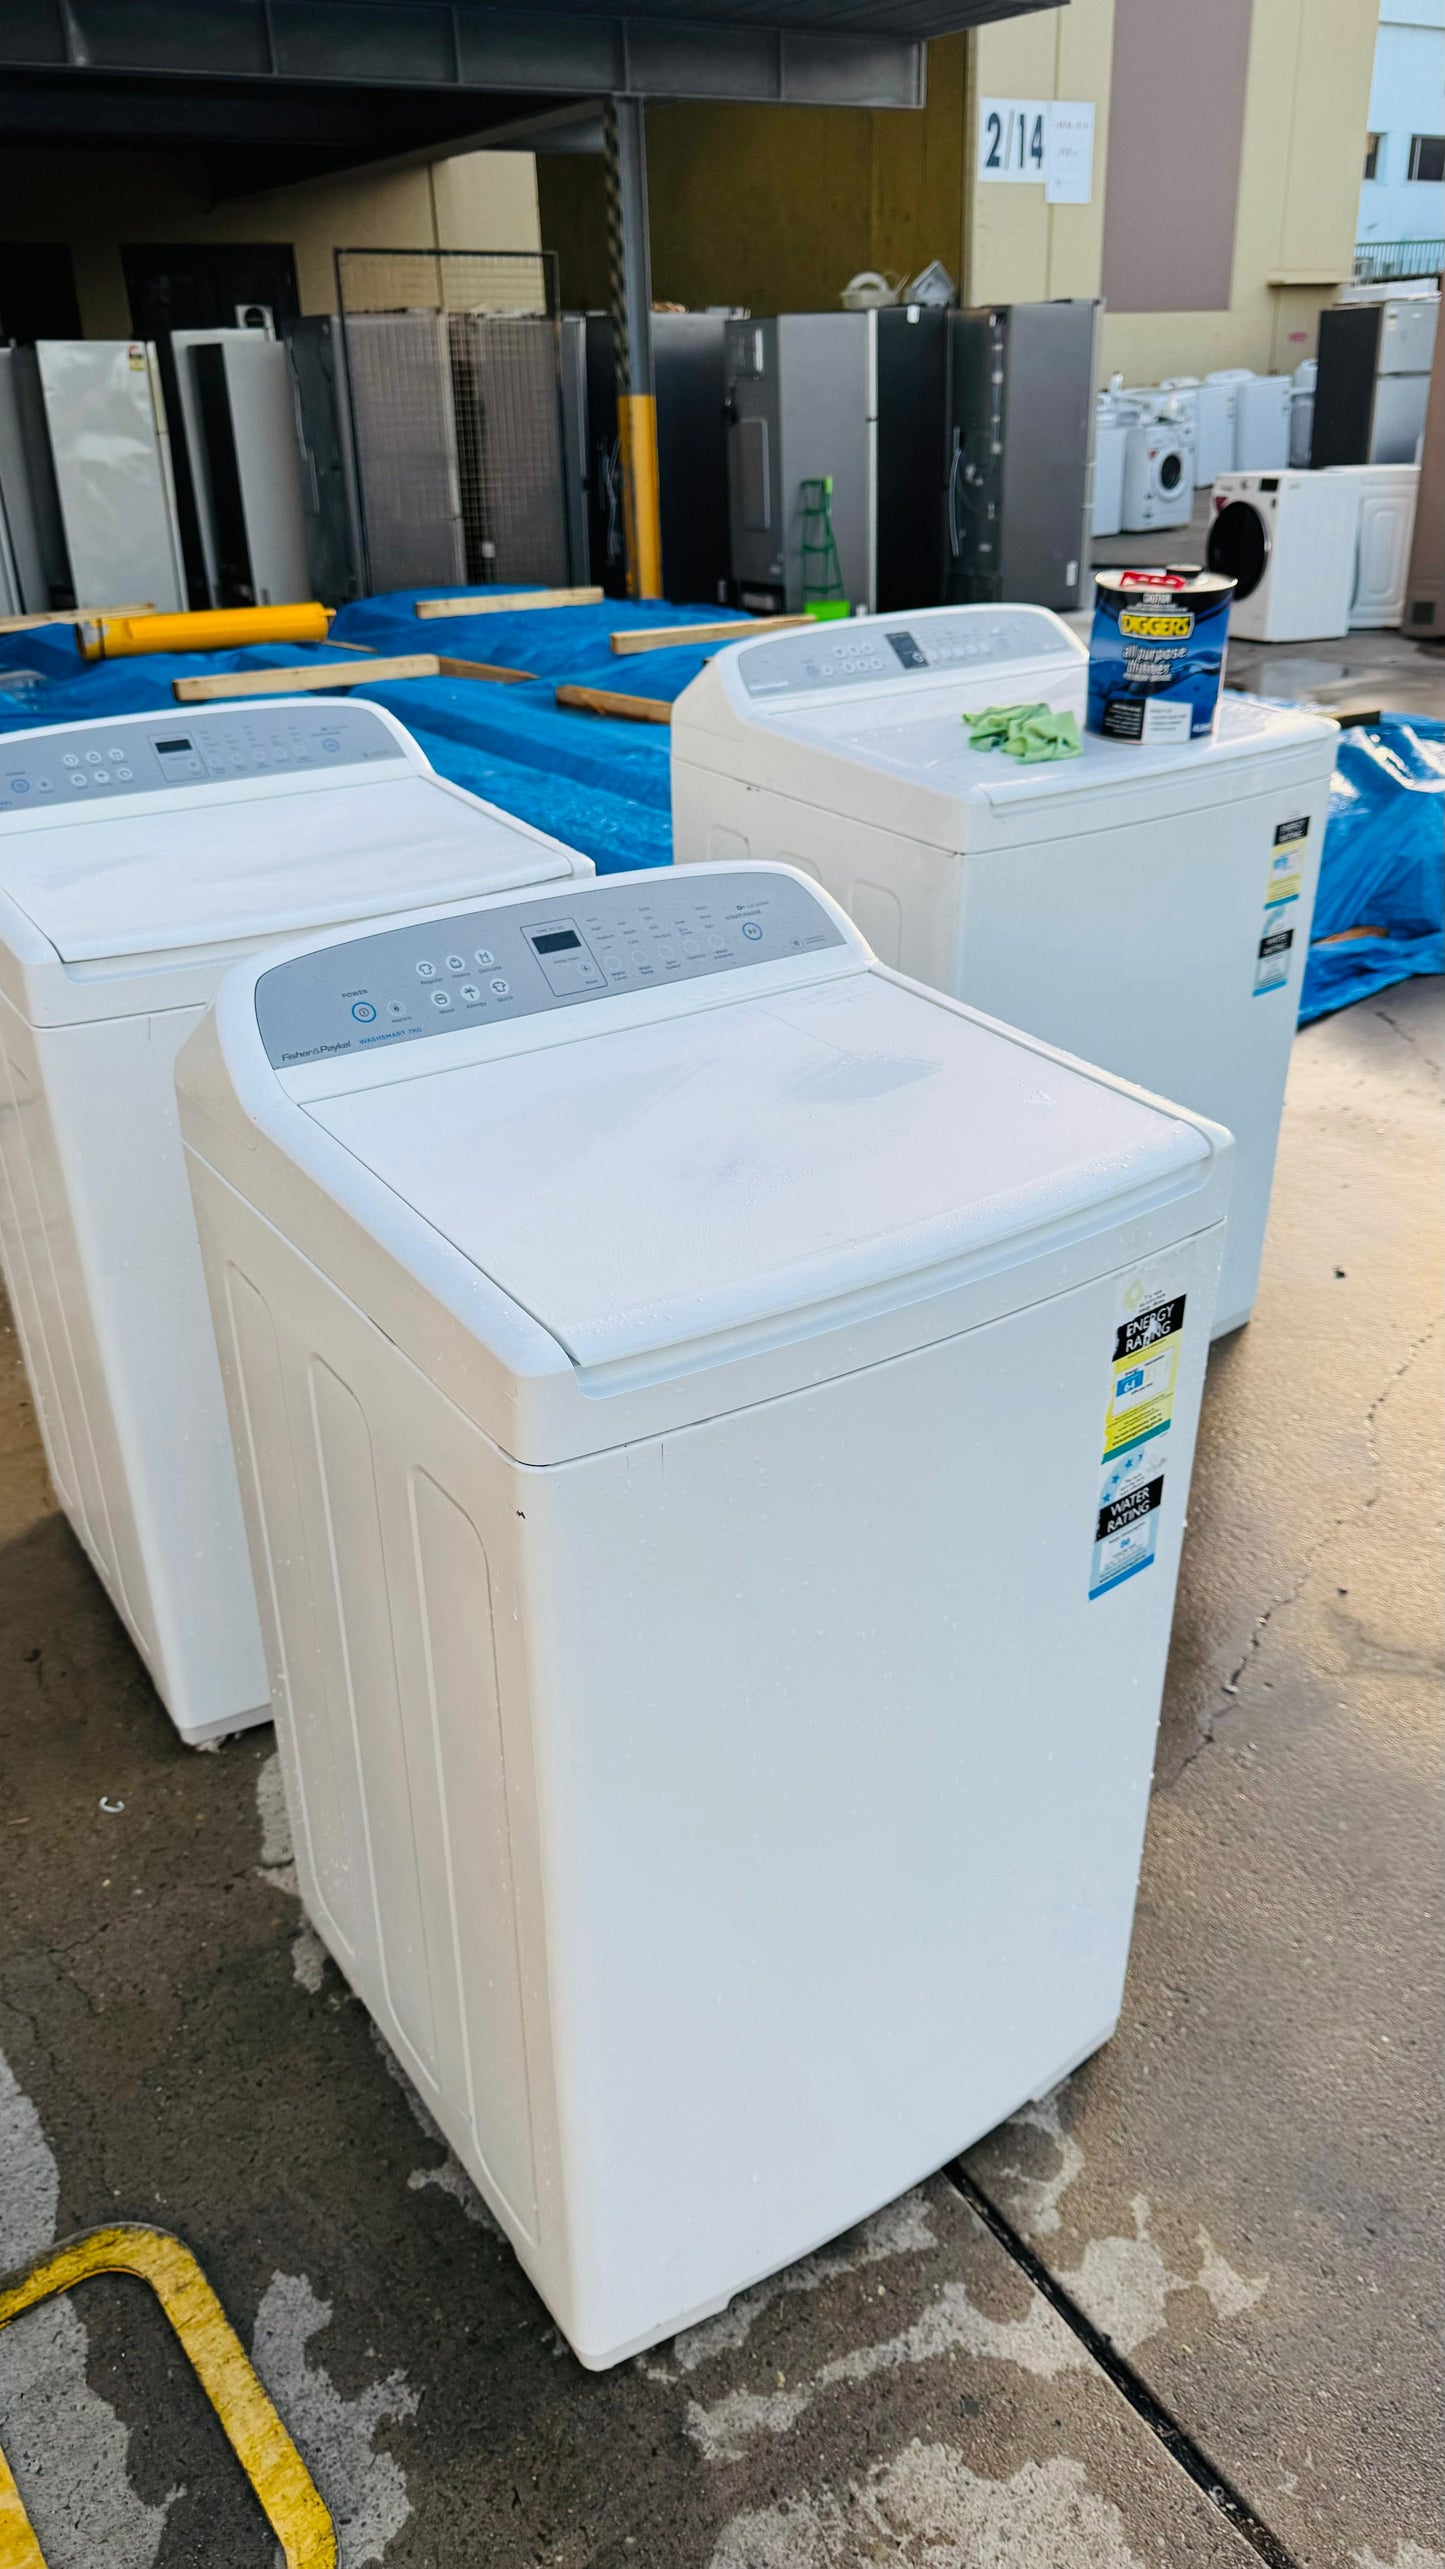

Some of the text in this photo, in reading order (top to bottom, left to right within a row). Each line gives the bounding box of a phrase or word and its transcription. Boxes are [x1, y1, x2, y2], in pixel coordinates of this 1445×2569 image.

[986, 110, 1043, 169] 2/14
[1121, 614, 1190, 638] DIGGERS
[1137, 647, 1187, 665] purpose
[341, 989, 369, 999] POWER
[359, 1030, 406, 1045] WASHSMART
[281, 1040, 351, 1062] Fisher&Paykel
[1110, 1487, 1151, 1516] WATER
[1107, 1499, 1151, 1533] RATING
